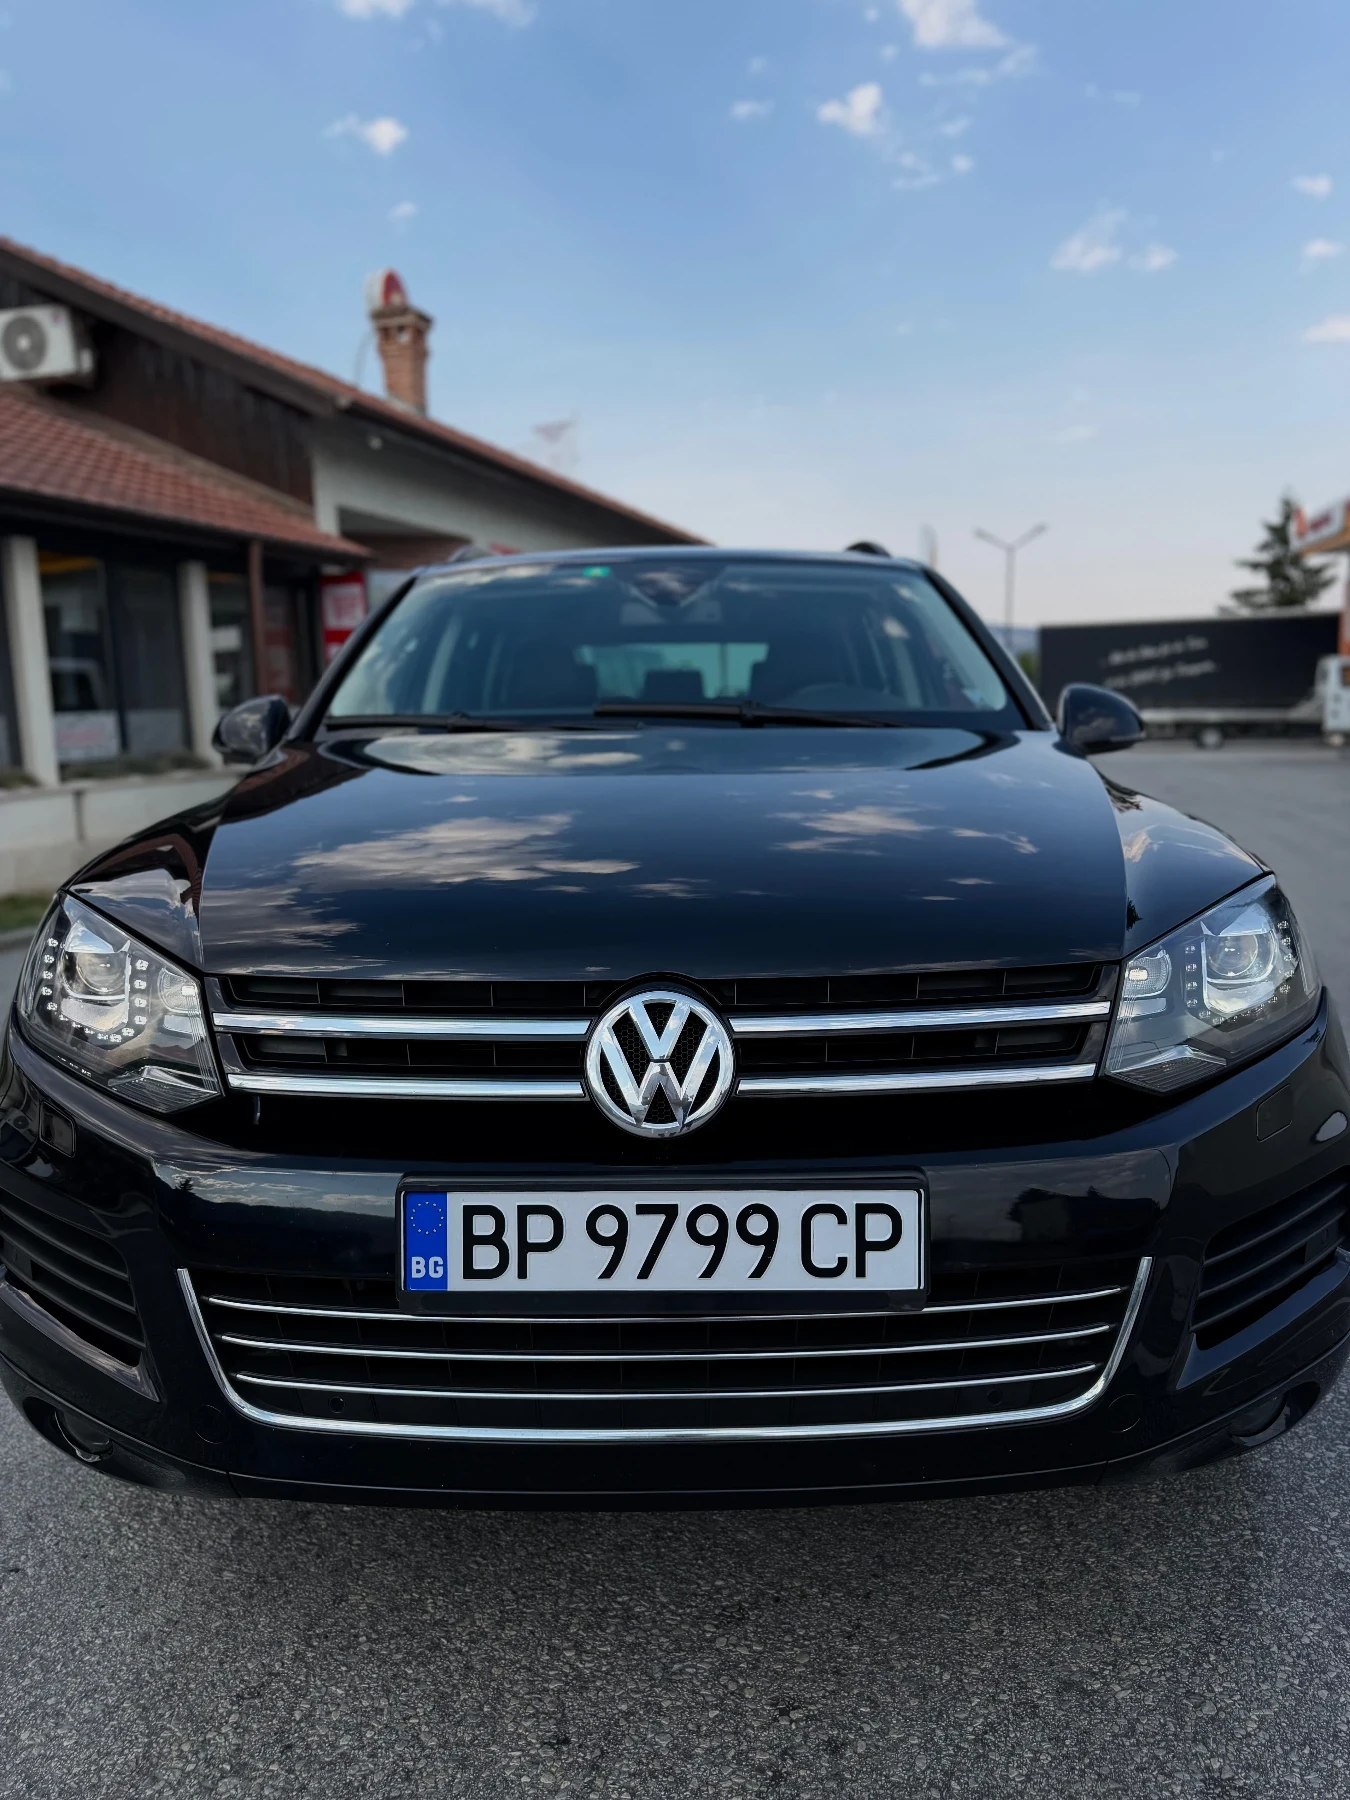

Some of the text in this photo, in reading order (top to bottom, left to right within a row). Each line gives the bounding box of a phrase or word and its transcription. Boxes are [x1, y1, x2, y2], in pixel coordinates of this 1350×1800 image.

[596, 993, 723, 1130] VW
[411, 1256, 444, 1279] BG
[462, 1202, 903, 1280] BP 9799 CP
